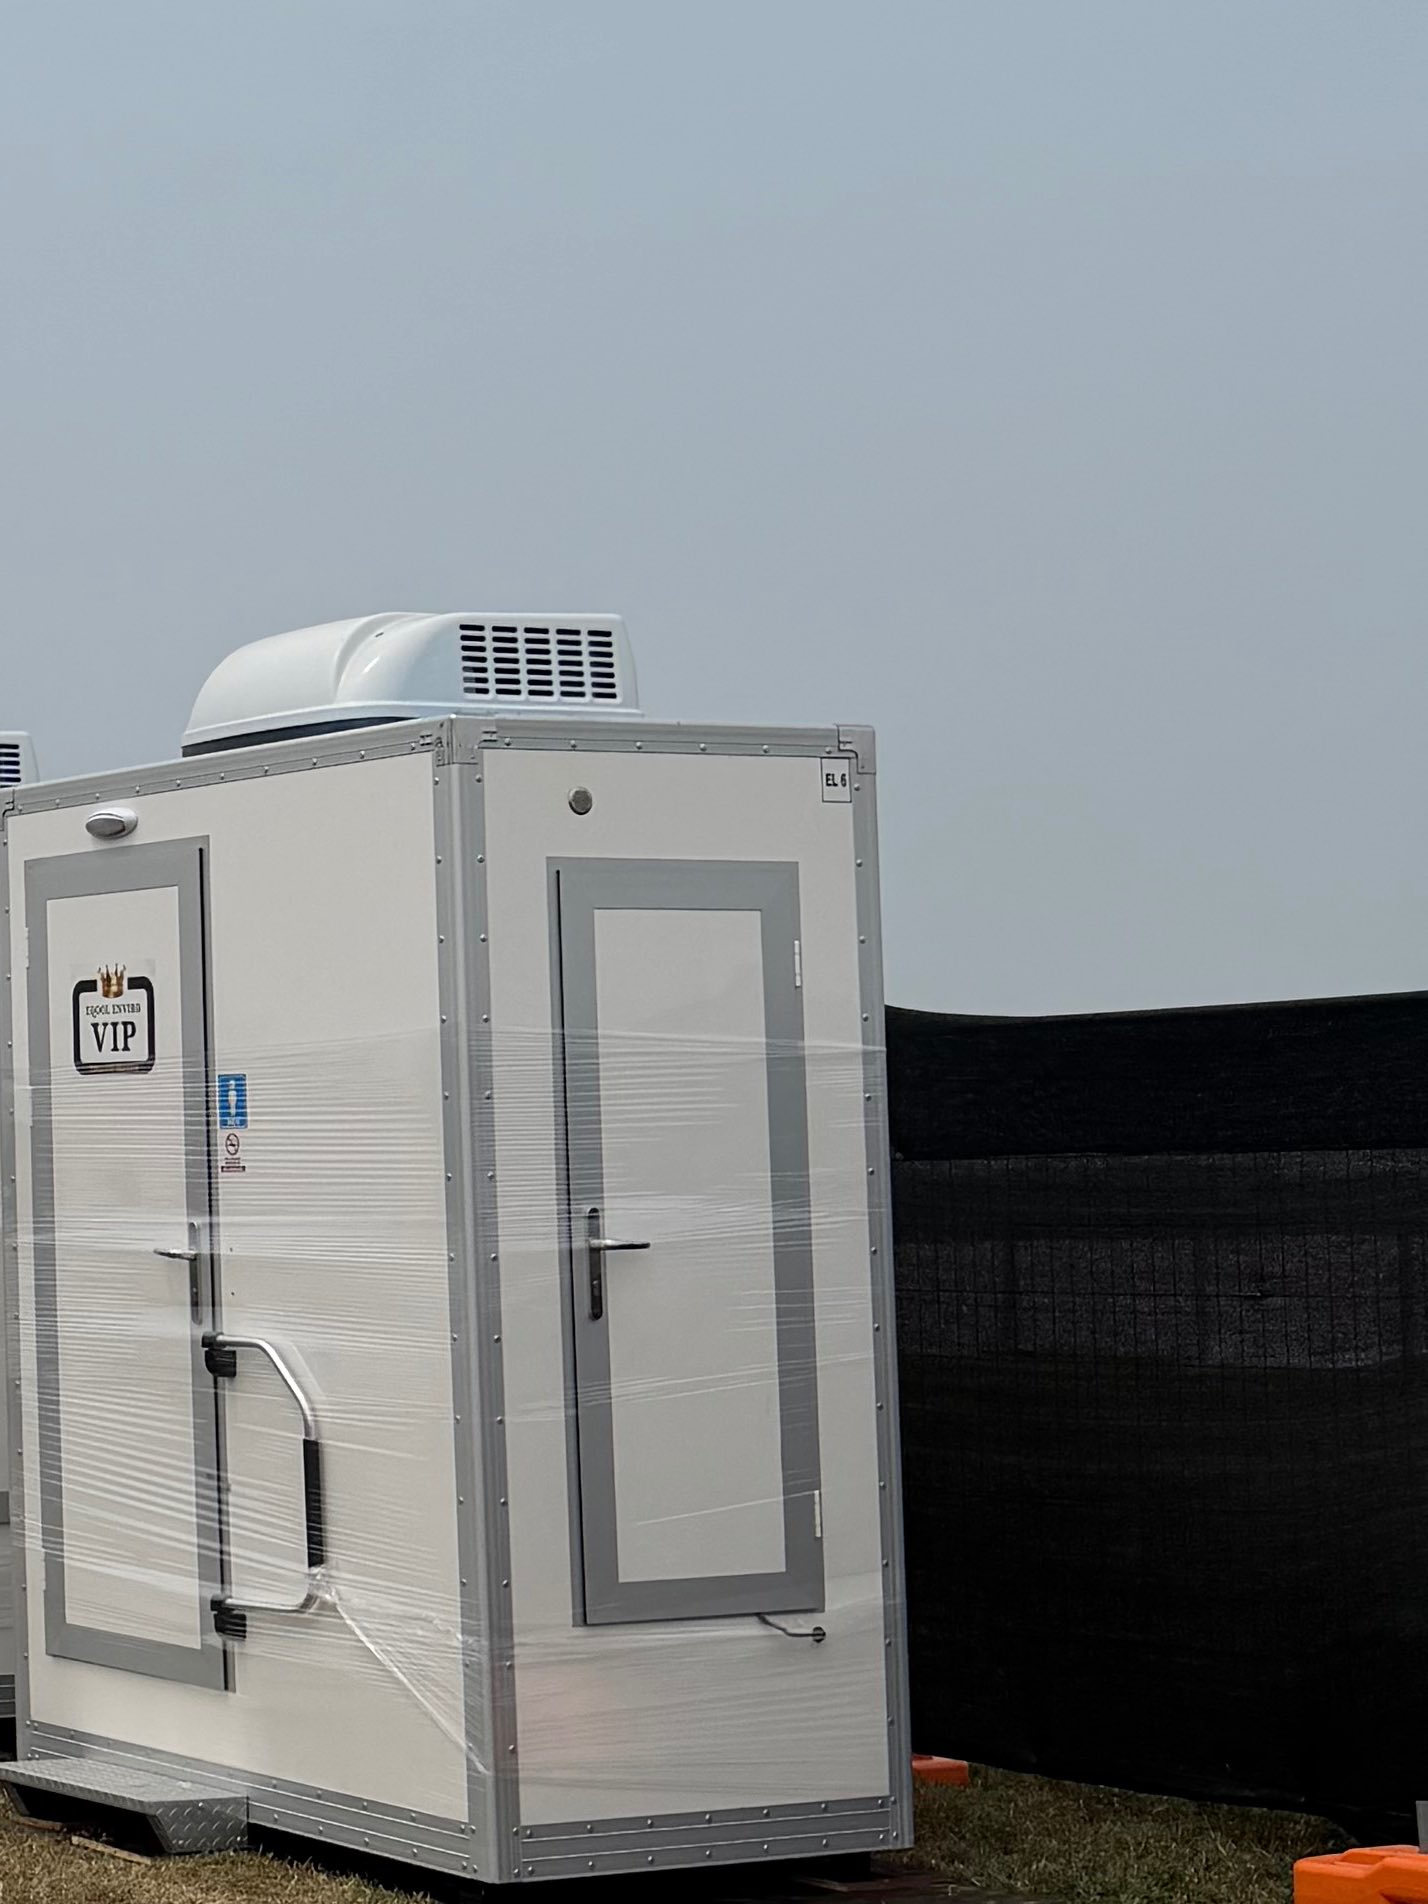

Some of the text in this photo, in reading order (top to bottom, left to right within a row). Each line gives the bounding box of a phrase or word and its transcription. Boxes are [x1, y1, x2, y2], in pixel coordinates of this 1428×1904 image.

[826, 773, 847, 788] EL 6
[91, 1021, 137, 1053] VIP
